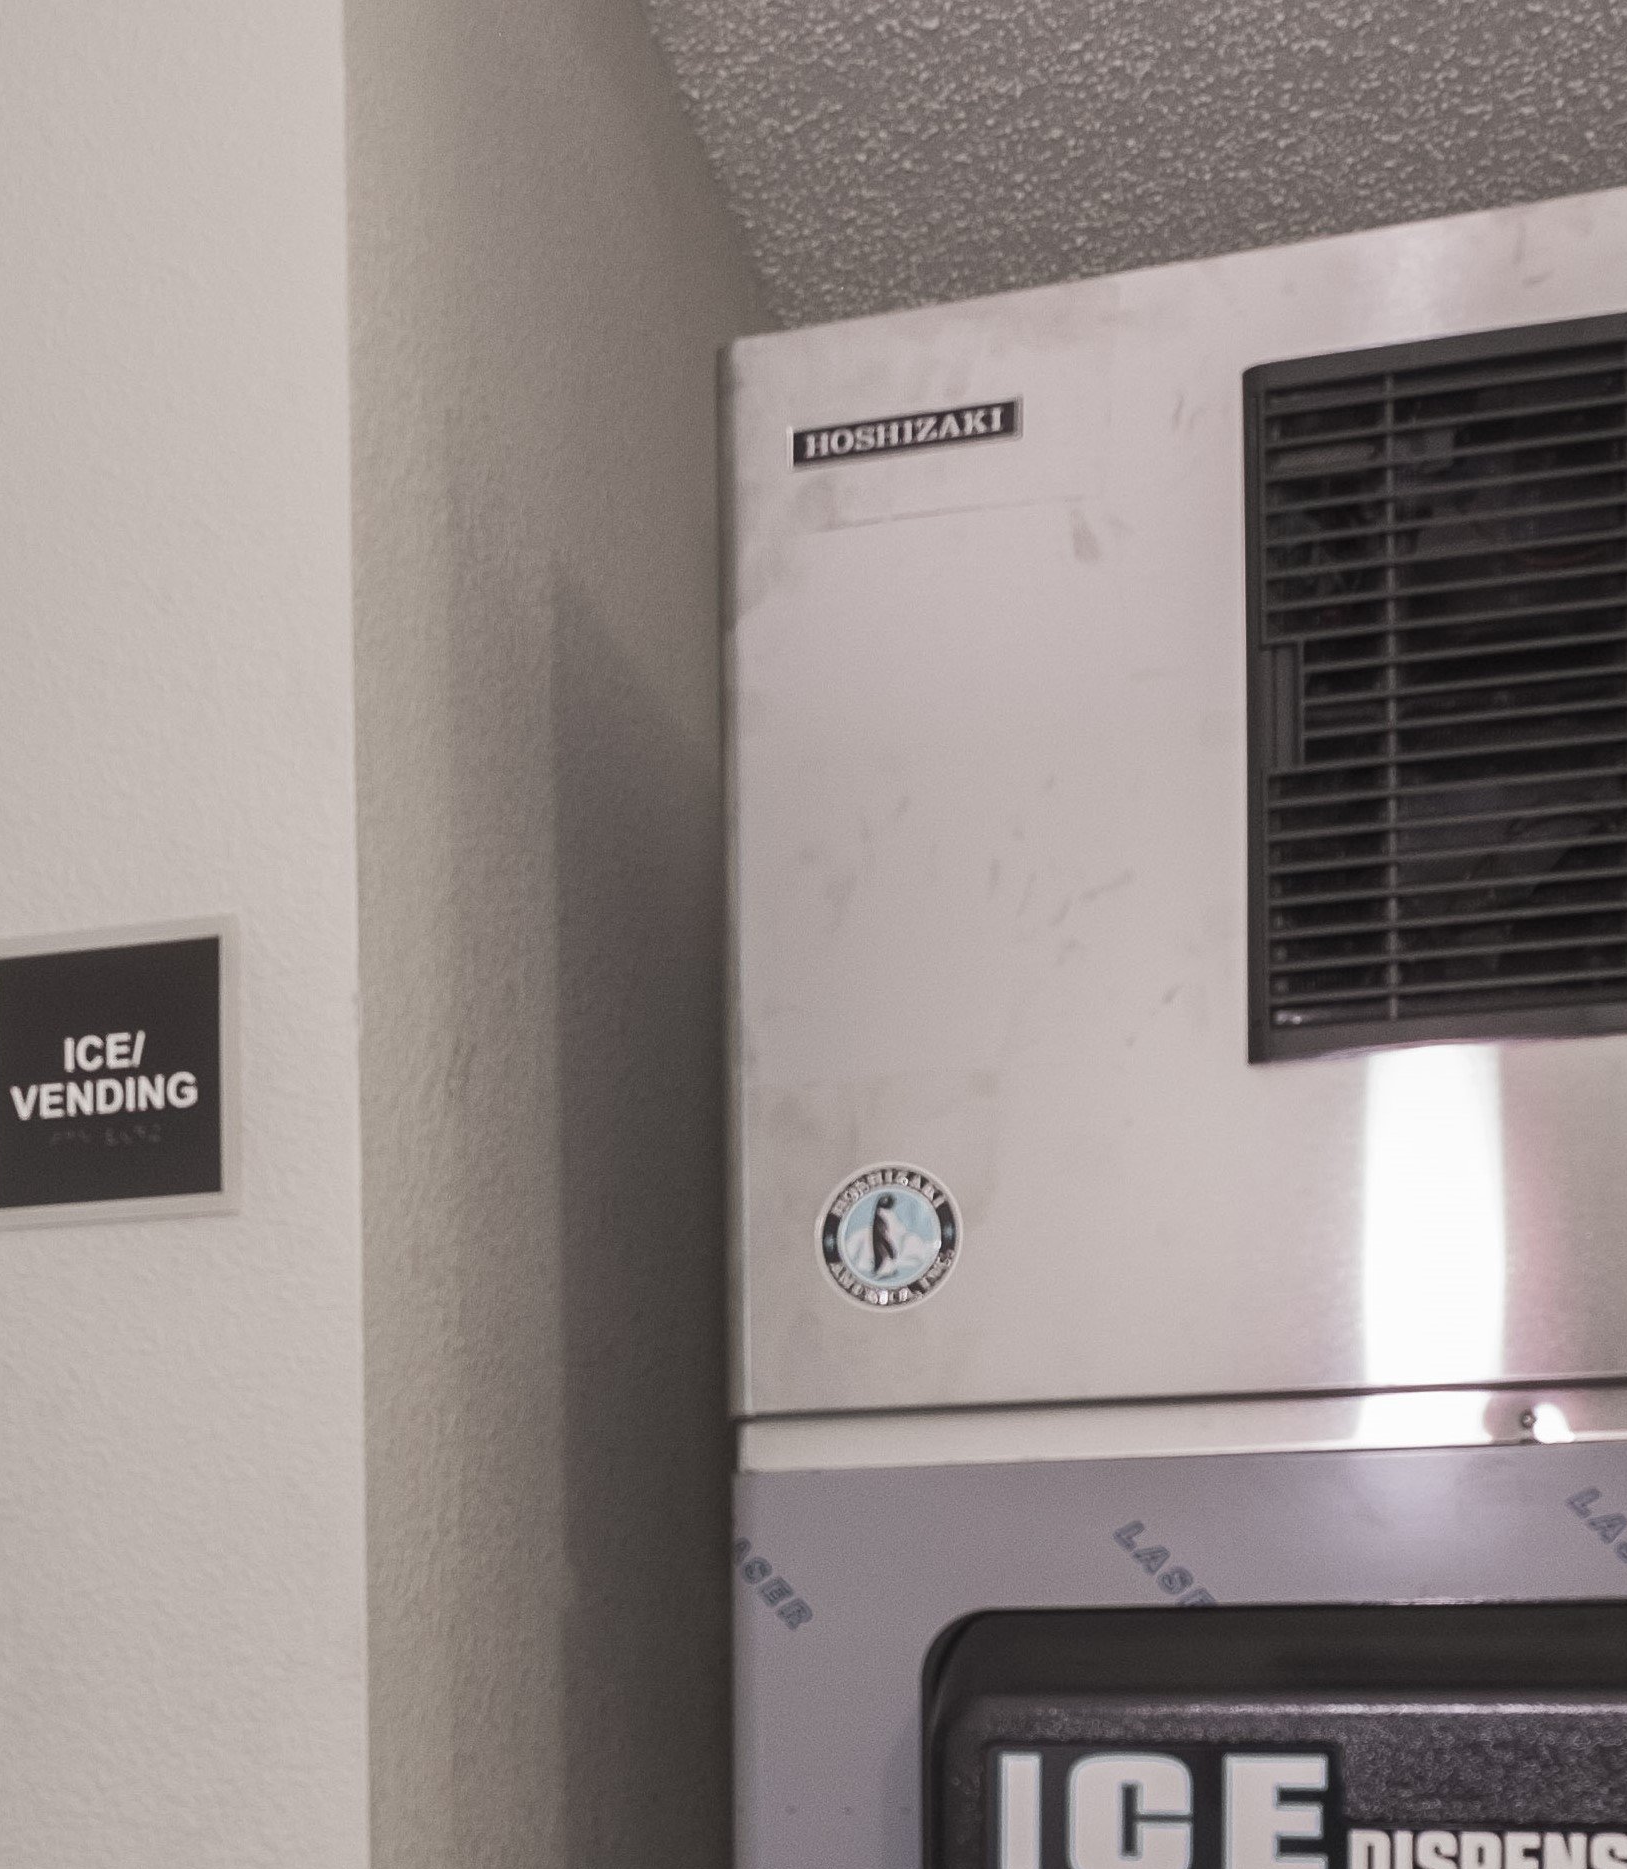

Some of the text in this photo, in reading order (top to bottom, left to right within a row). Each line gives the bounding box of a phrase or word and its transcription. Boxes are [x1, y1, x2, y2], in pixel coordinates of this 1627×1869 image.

[804, 406, 1004, 459] HOSHIZAKI
[63, 1029, 146, 1073] ICE/
[9, 1070, 199, 1121] VENDING
